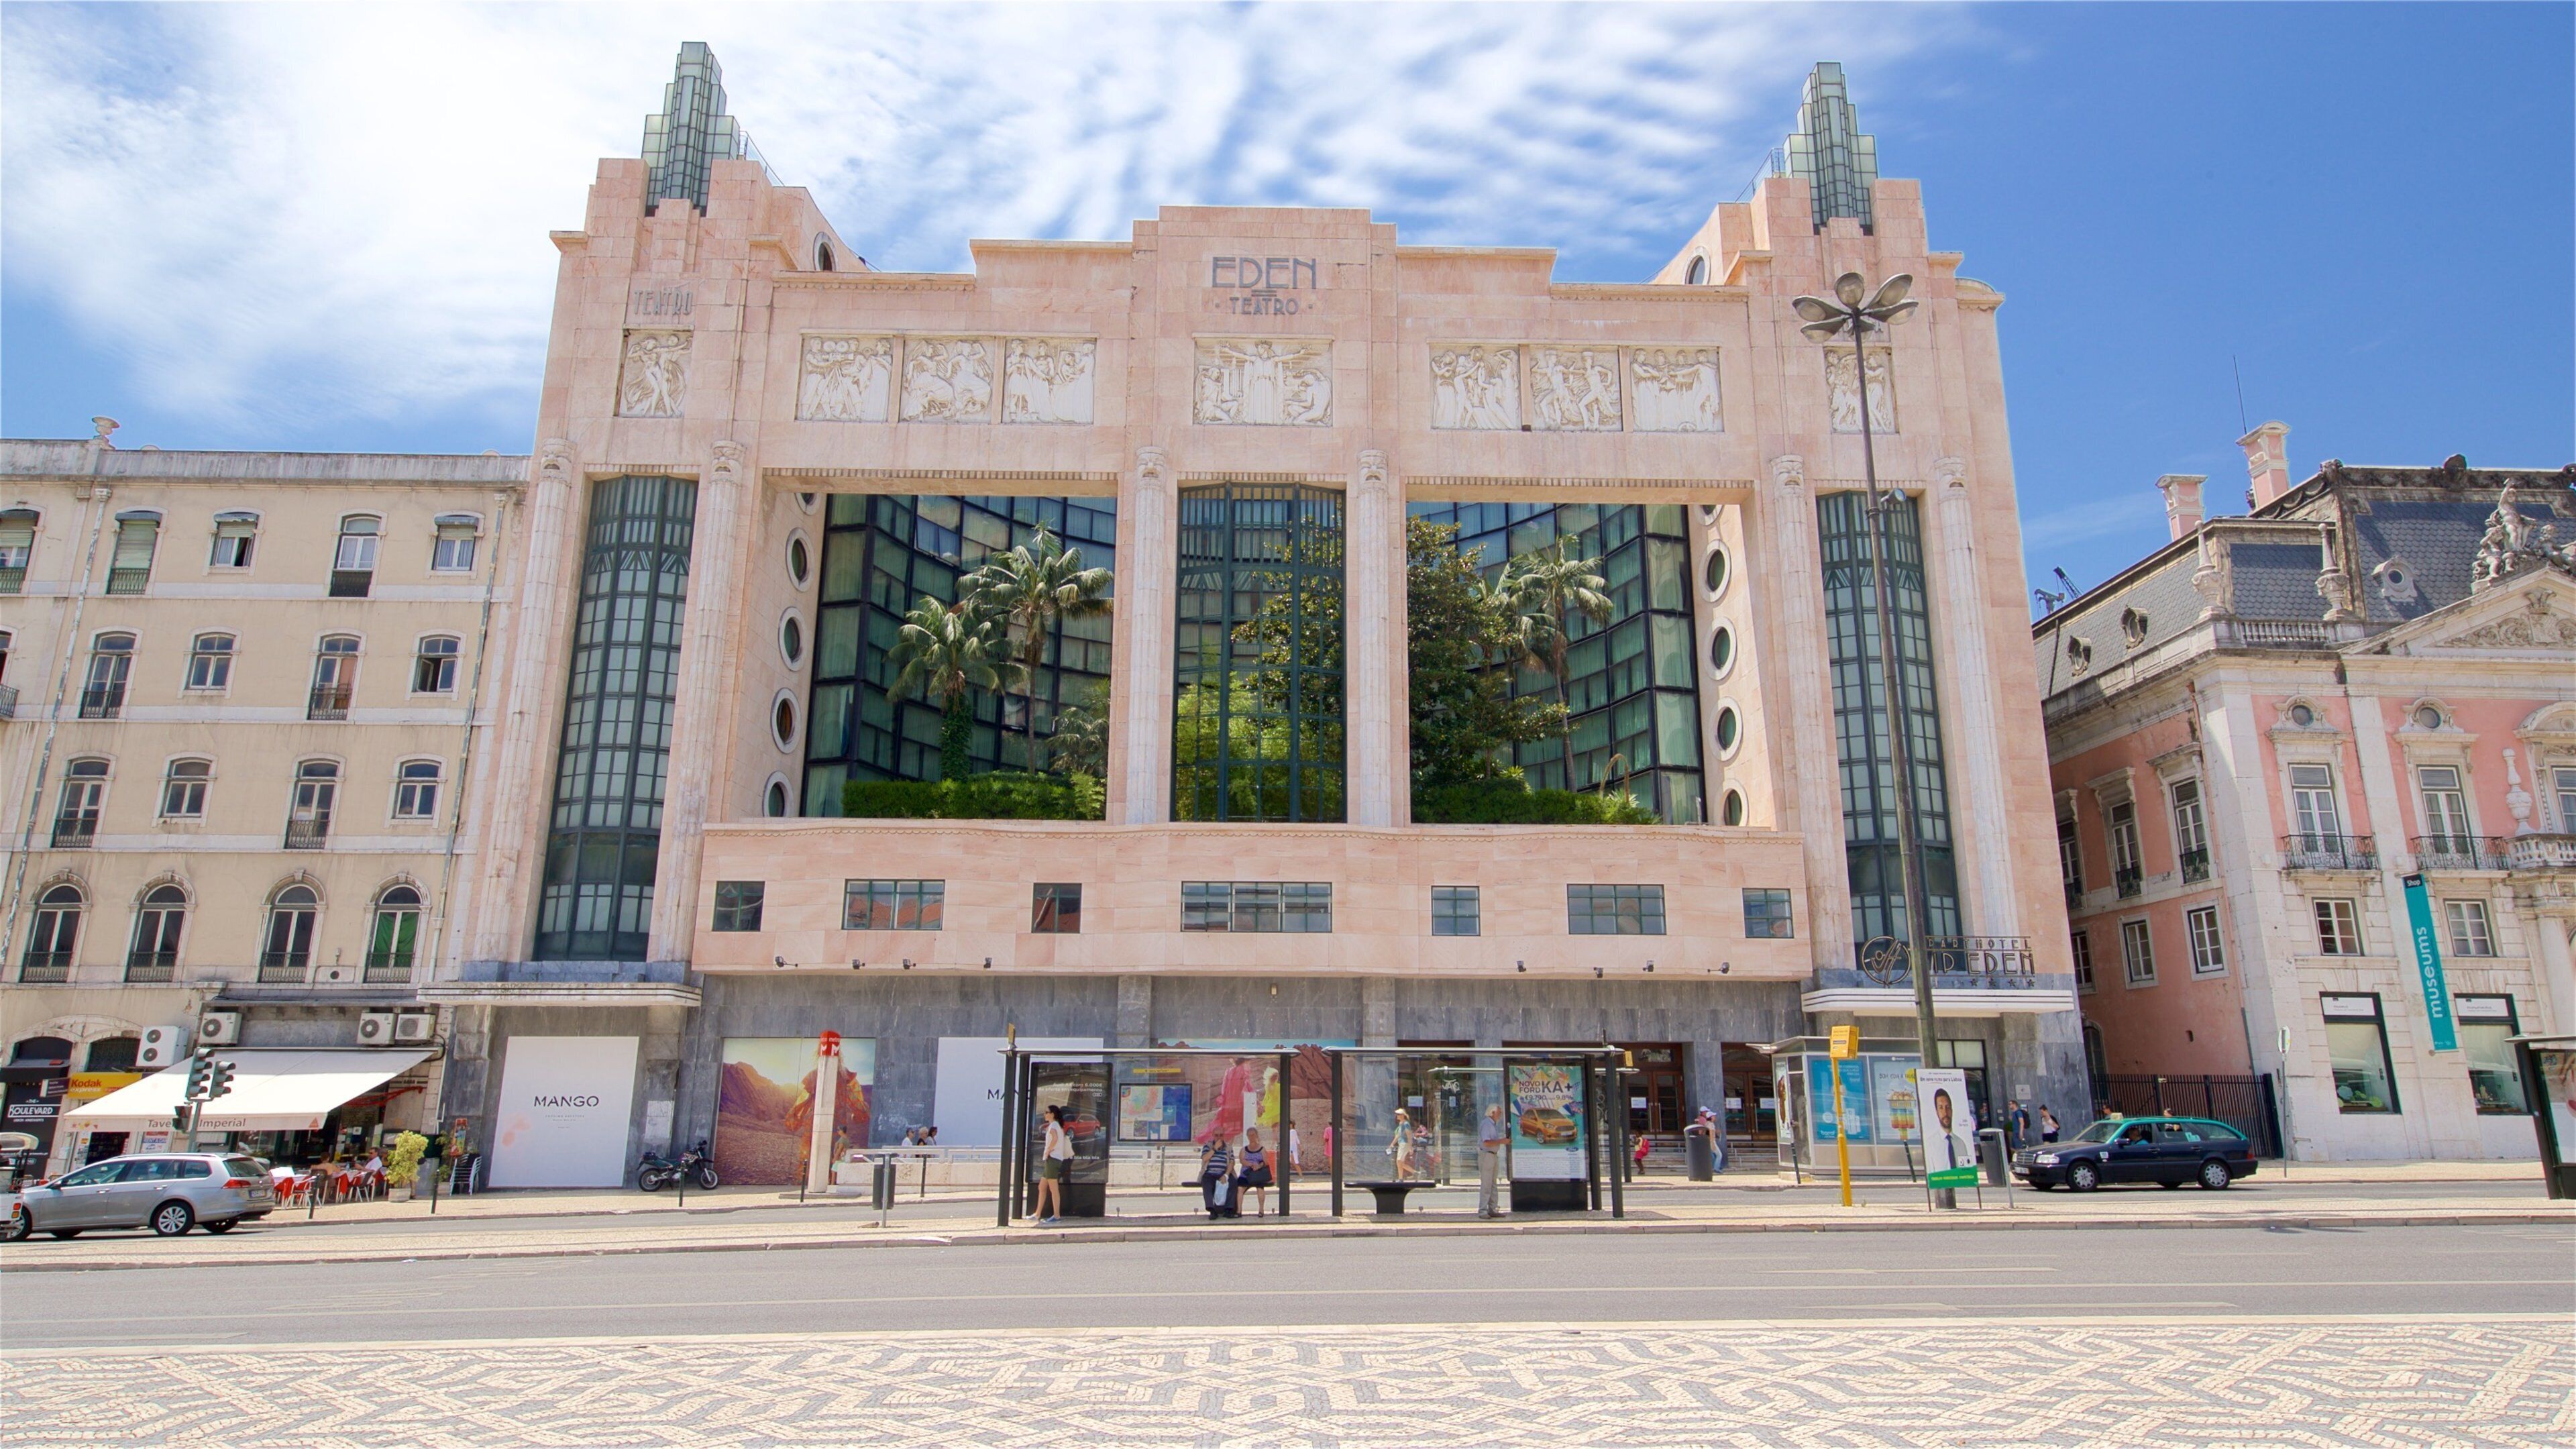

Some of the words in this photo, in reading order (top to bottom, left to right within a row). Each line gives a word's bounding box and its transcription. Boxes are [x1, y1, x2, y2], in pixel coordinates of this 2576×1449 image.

[1212, 256, 1316, 289] EDEN
[633, 287, 693, 316] TEATRO
[1229, 297, 1299, 316] TEATRO
[2406, 879, 2421, 887] Shop
[2416, 926, 2443, 1018] museums
[70, 1079, 102, 1088] Kodak
[533, 1095, 599, 1107] MANGO
[8, 1106, 54, 1118] BOULEVARD
[199, 1118, 246, 1130] Imperial
